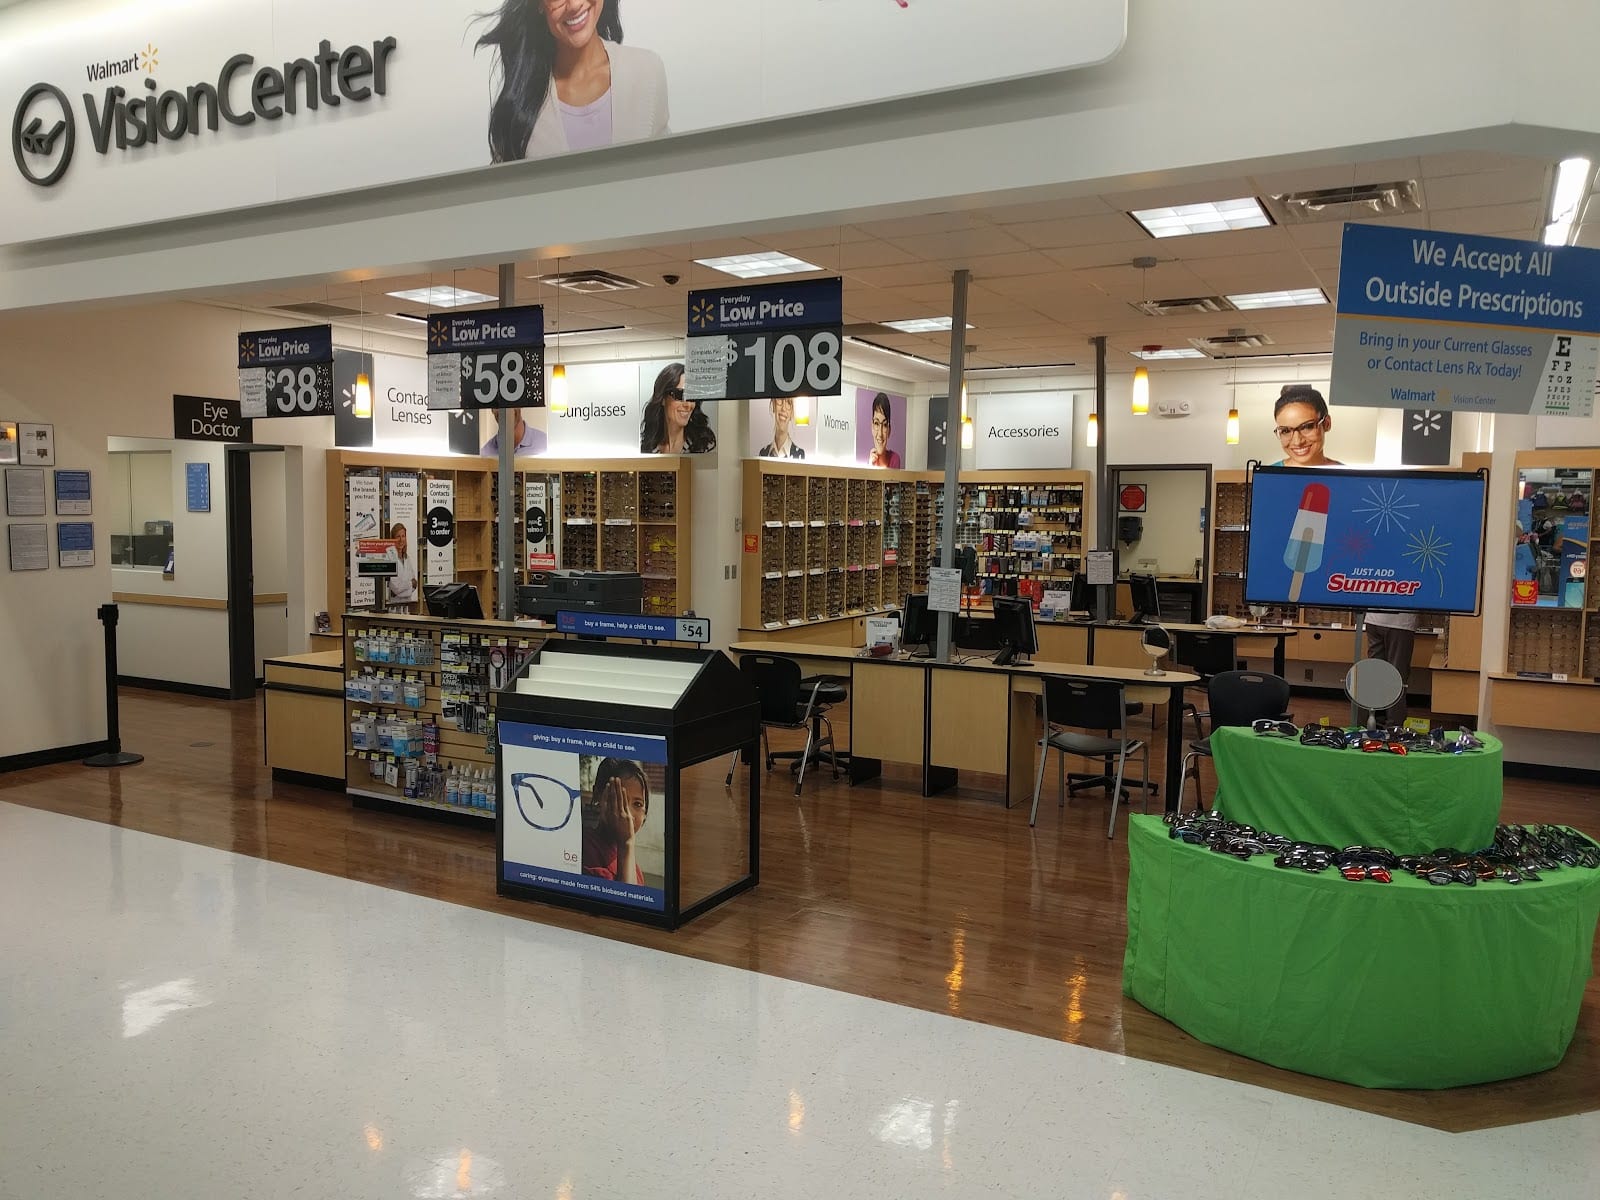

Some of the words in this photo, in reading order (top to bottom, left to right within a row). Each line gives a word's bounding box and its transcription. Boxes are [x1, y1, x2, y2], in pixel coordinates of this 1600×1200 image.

[87, 53, 139, 81] Walmart
[83, 35, 397, 154] VisionCenter
[1412, 239, 1447, 266] We
[1452, 243, 1522, 278] Accept
[1527, 252, 1552, 276] All
[720, 295, 750, 304] Everyday
[1365, 276, 1452, 307] Outside
[1458, 284, 1583, 319] Prescriptions
[720, 305, 756, 322] Low
[759, 298, 804, 319] Price
[452, 318, 476, 326] Everyday
[452, 326, 480, 342] Low
[482, 323, 516, 340] Price
[259, 344, 281, 357] Low
[282, 340, 309, 356] Price
[1359, 331, 1393, 350] Bring
[1398, 335, 1409, 349] in
[1411, 339, 1441, 353] your
[1444, 337, 1488, 354] Current
[1491, 340, 1533, 356] Glasses
[1556, 336, 1571, 357] E
[726, 332, 840, 393] $108
[1367, 359, 1381, 369] or
[1384, 357, 1434, 372] Contact
[1436, 360, 1464, 374] Lens
[1466, 362, 1482, 375] Rx
[1485, 363, 1522, 380] Today!
[462, 352, 525, 404] $58
[267, 367, 317, 413] $38
[387, 387, 429, 406] Contac
[1390, 387, 1436, 402] Walmart
[1453, 395, 1473, 405] Vision
[1474, 395, 1496, 405] Center
[203, 401, 229, 422] Eye
[391, 405, 432, 425] Lenses
[191, 419, 241, 437] Doctor
[824, 414, 849, 430] Women
[988, 424, 1059, 439] Accessories
[392, 490, 403, 498] help
[429, 482, 450, 490] Ordering
[431, 517, 438, 528] 3
[436, 528, 450, 536] order
[1352, 568, 1374, 576] JUST
[1374, 568, 1395, 577] ADD
[1327, 573, 1421, 595] Summer
[584, 620, 594, 628] buy
[599, 620, 616, 629] frame,
[616, 622, 627, 630] help
[682, 624, 703, 638] $54
[532, 734, 550, 743] giving:
[551, 736, 561, 744] buy
[566, 737, 583, 746] frame,
[584, 739, 597, 748] help
[602, 740, 617, 749] child
[519, 871, 537, 881] caring:
[538, 876, 560, 884] eyewear
[560, 879, 575, 887] made
[577, 881, 589, 890] from
[590, 885, 601, 893] 54%
[602, 886, 627, 897] biobased
[627, 892, 655, 903] materials.
